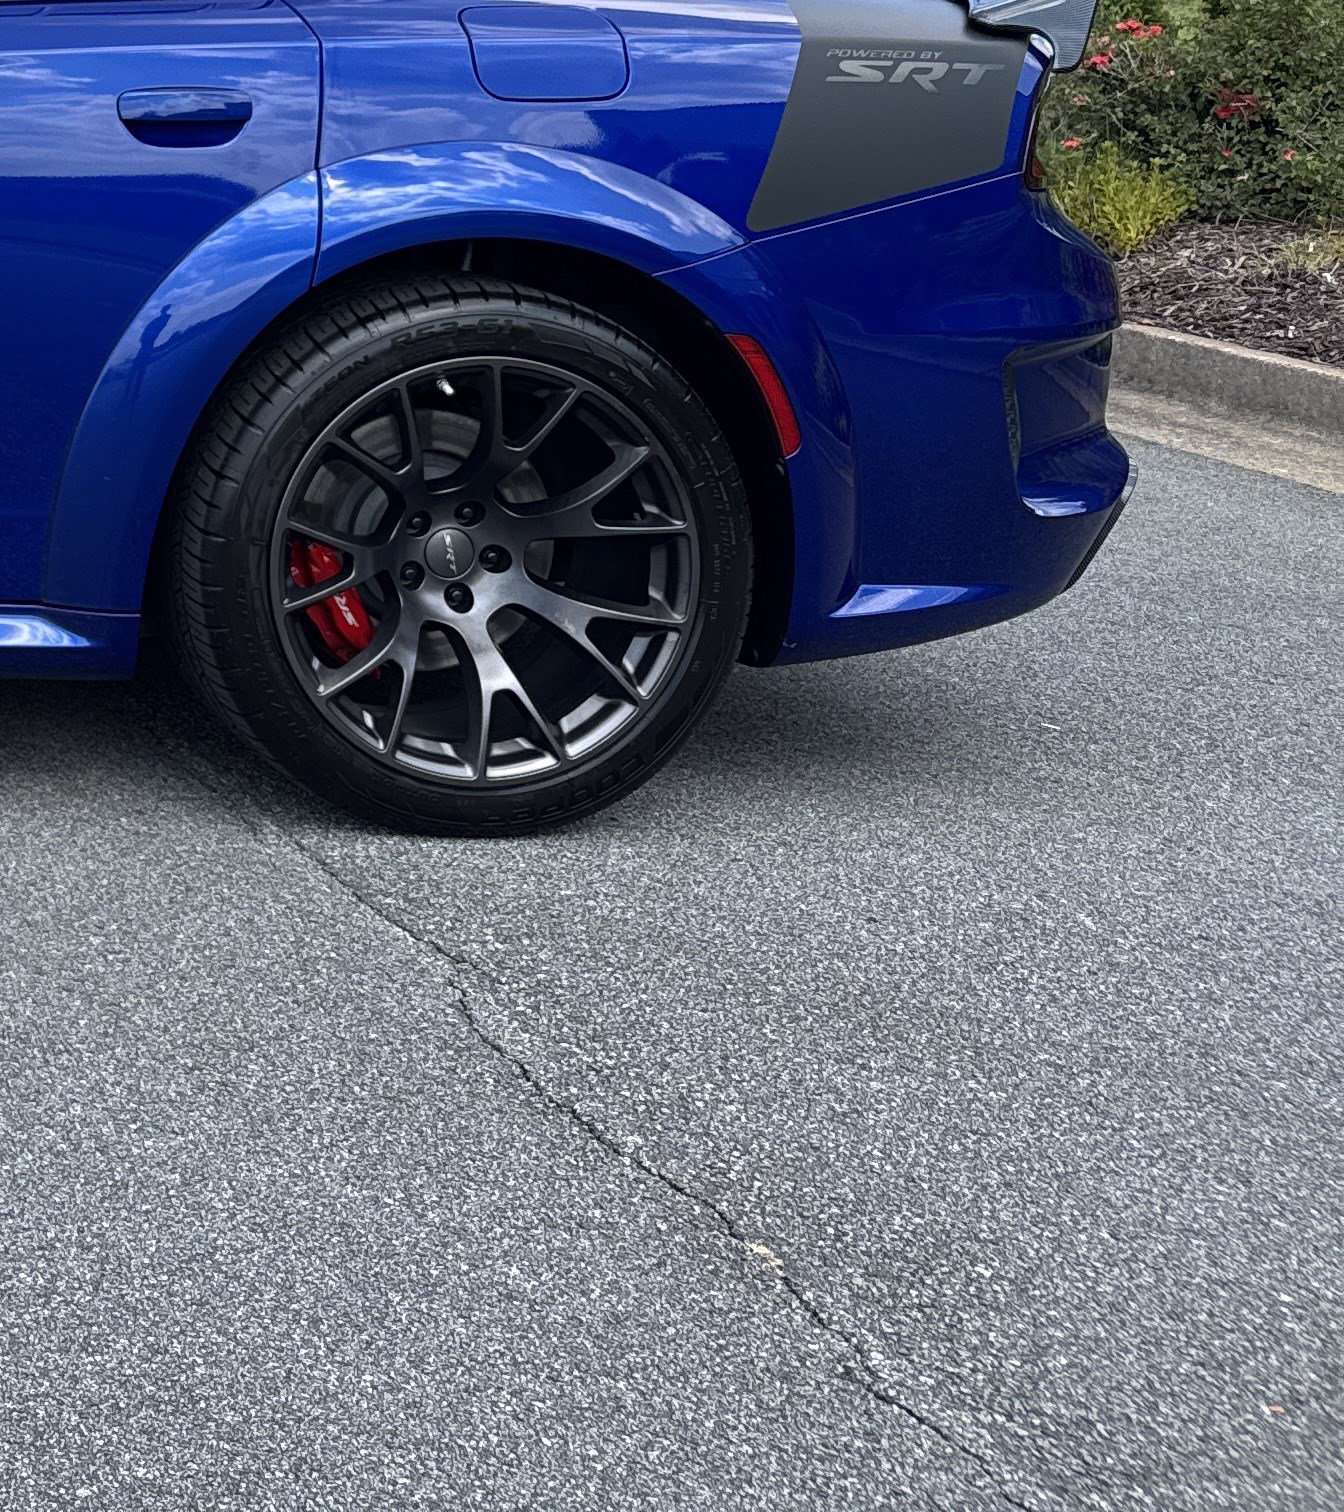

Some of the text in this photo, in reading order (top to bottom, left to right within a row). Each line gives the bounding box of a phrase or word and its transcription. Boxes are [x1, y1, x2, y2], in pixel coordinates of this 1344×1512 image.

[825, 48, 943, 59] POWERED BY
[825, 60, 1006, 94] SRT
